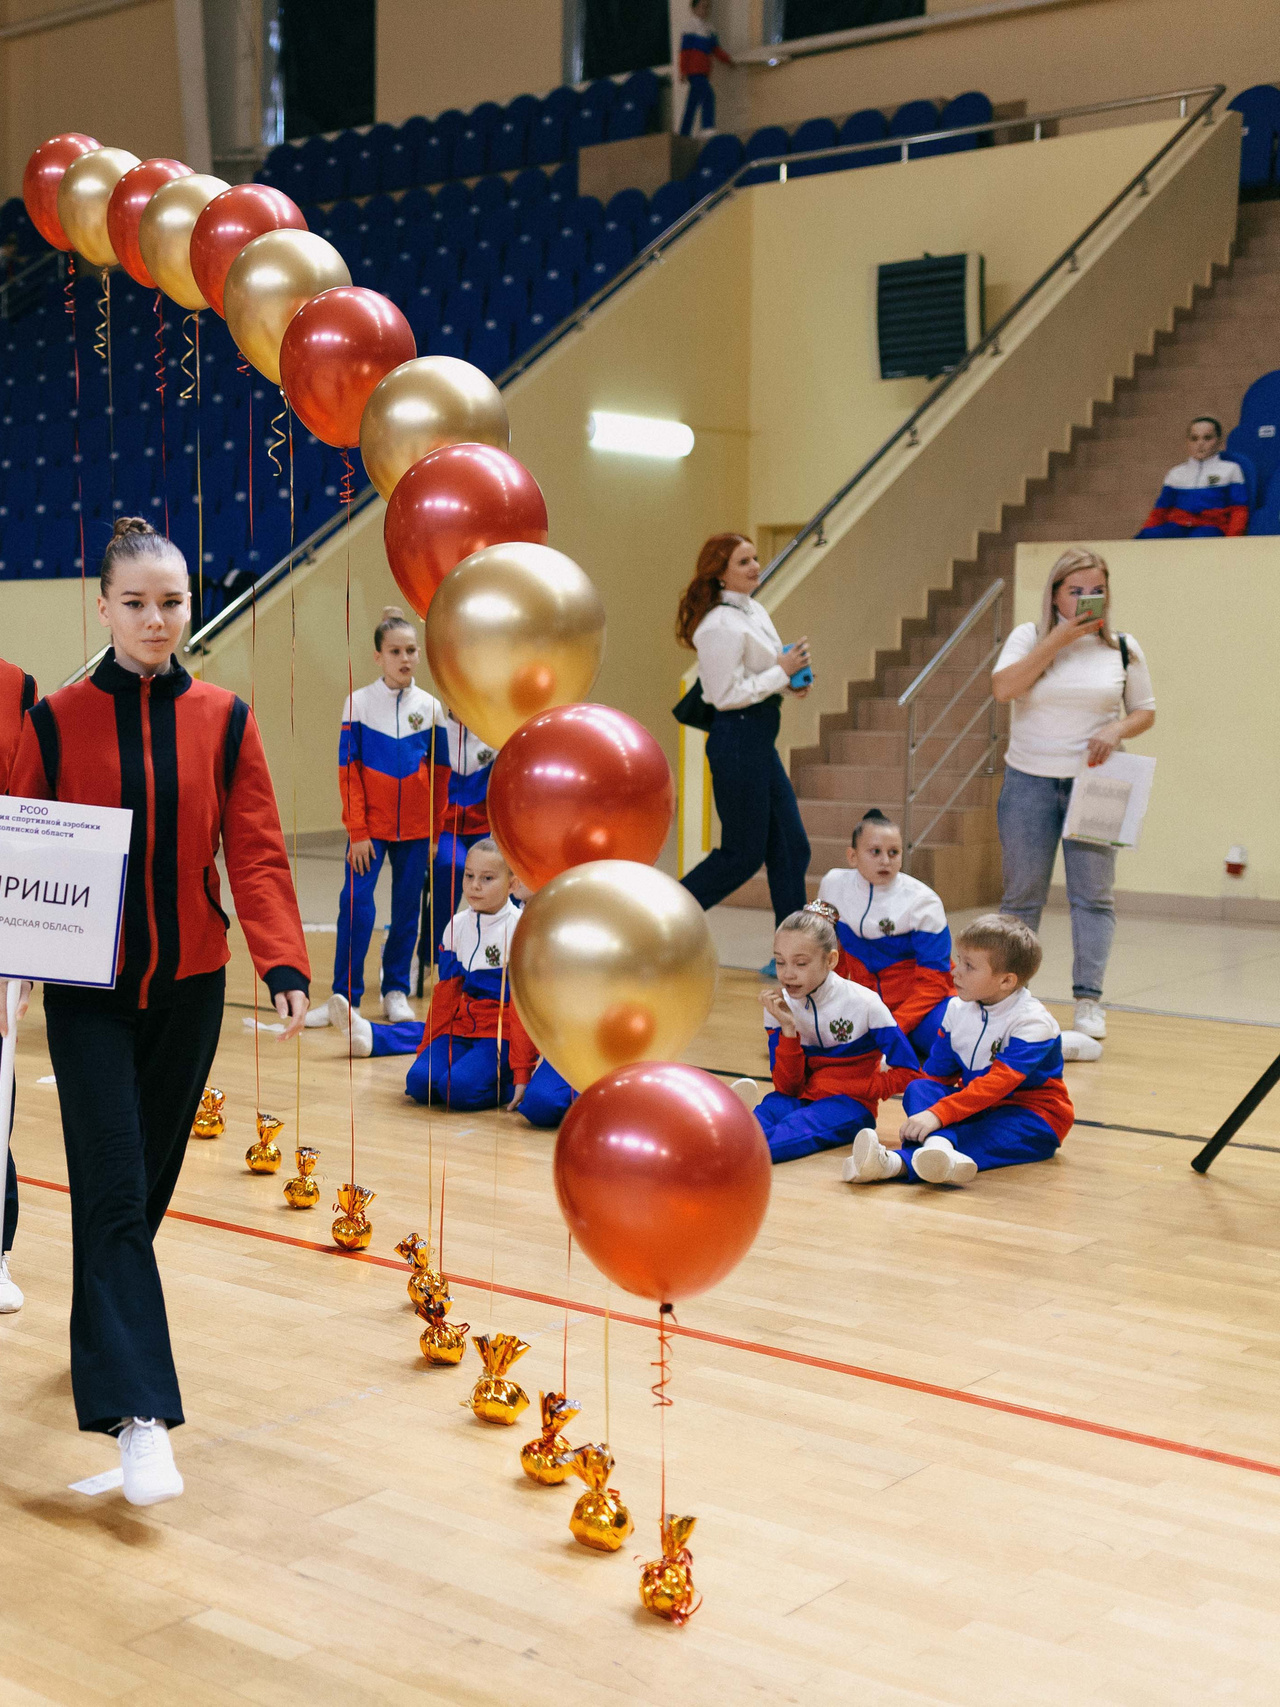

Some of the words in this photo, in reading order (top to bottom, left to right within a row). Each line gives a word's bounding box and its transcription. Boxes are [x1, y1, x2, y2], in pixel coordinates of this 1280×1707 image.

[19, 804, 49, 816] РСОО
[11, 816, 61, 827] спортивной
[62, 820, 101, 831] аэробики
[41, 827, 74, 838] области
[42, 921, 84, 934] ОБЛАСТЬ
